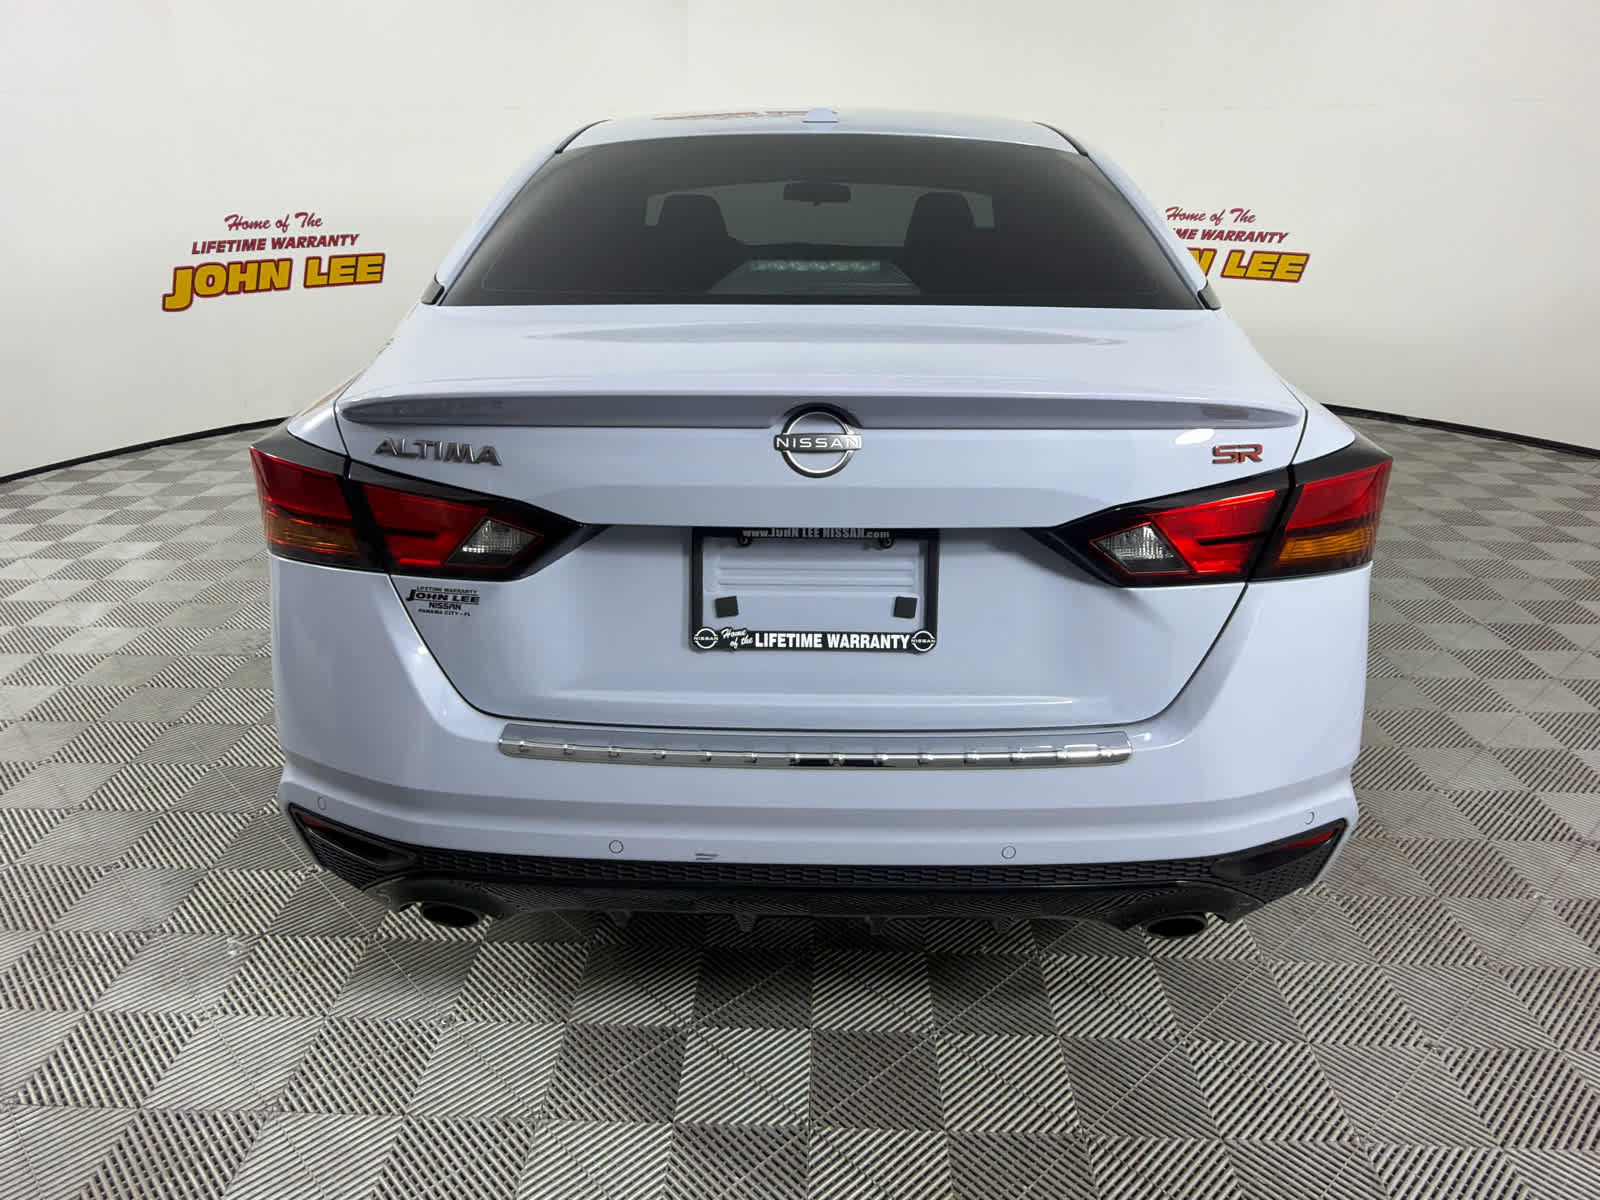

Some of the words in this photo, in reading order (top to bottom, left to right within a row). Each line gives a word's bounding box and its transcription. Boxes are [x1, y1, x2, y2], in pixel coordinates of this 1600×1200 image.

[224, 213, 271, 231] Home
[275, 214, 291, 233] of
[294, 211, 323, 228] The
[1165, 206, 1206, 222] Home
[1209, 209, 1226, 226] of
[1230, 208, 1256, 224] The
[191, 238, 267, 255] LIFETIME
[271, 233, 360, 250] WARRANTY
[1200, 229, 1288, 244] WARRANTY
[1220, 249, 1310, 284] LEE
[162, 258, 293, 312] JOHN
[303, 253, 386, 288] LEE
[374, 437, 502, 466] ALTIMA
[776, 437, 862, 449] NISSAN
[1212, 443, 1263, 464] SR
[802, 528, 820, 538] LEE
[406, 589, 449, 601] JOHN
[452, 595, 480, 603] LEE
[429, 602, 462, 610] NISSAN
[721, 628, 747, 639] Home
[730, 636, 739, 649] of
[741, 634, 753, 645] the
[755, 633, 822, 649] LIFETIME
[827, 634, 910, 650] WARRANTY
